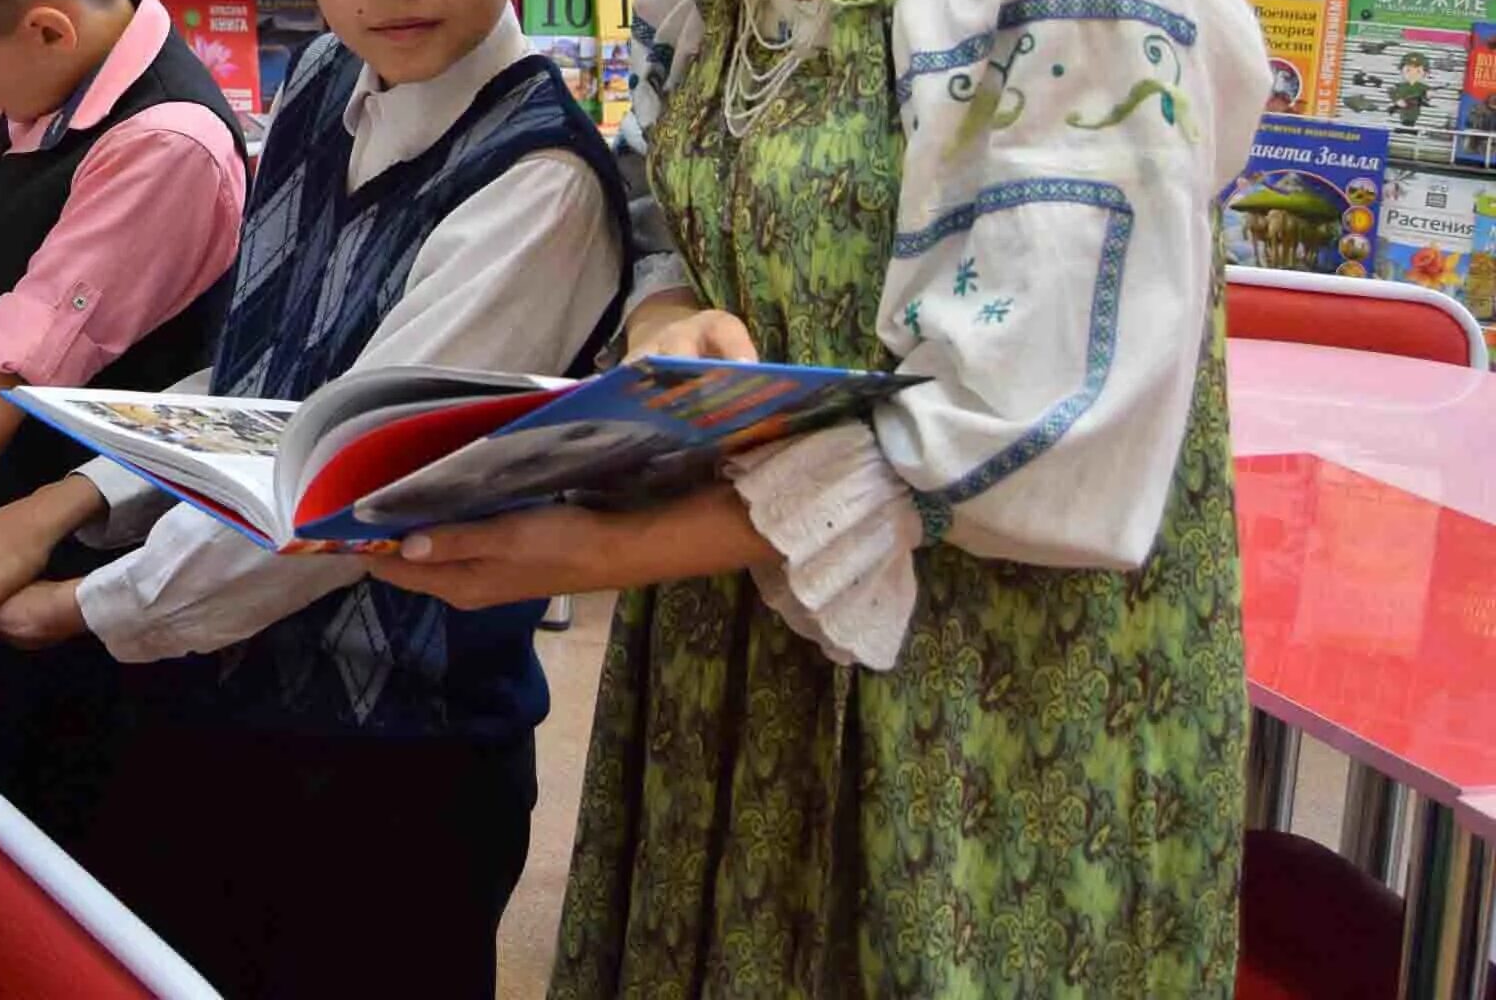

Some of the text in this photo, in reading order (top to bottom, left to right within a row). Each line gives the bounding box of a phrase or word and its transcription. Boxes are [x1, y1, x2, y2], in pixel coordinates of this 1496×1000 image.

[1261, 24, 1315, 38] стория
[1315, 146, 1380, 171] Земля
[1386, 209, 1474, 236] Растения
